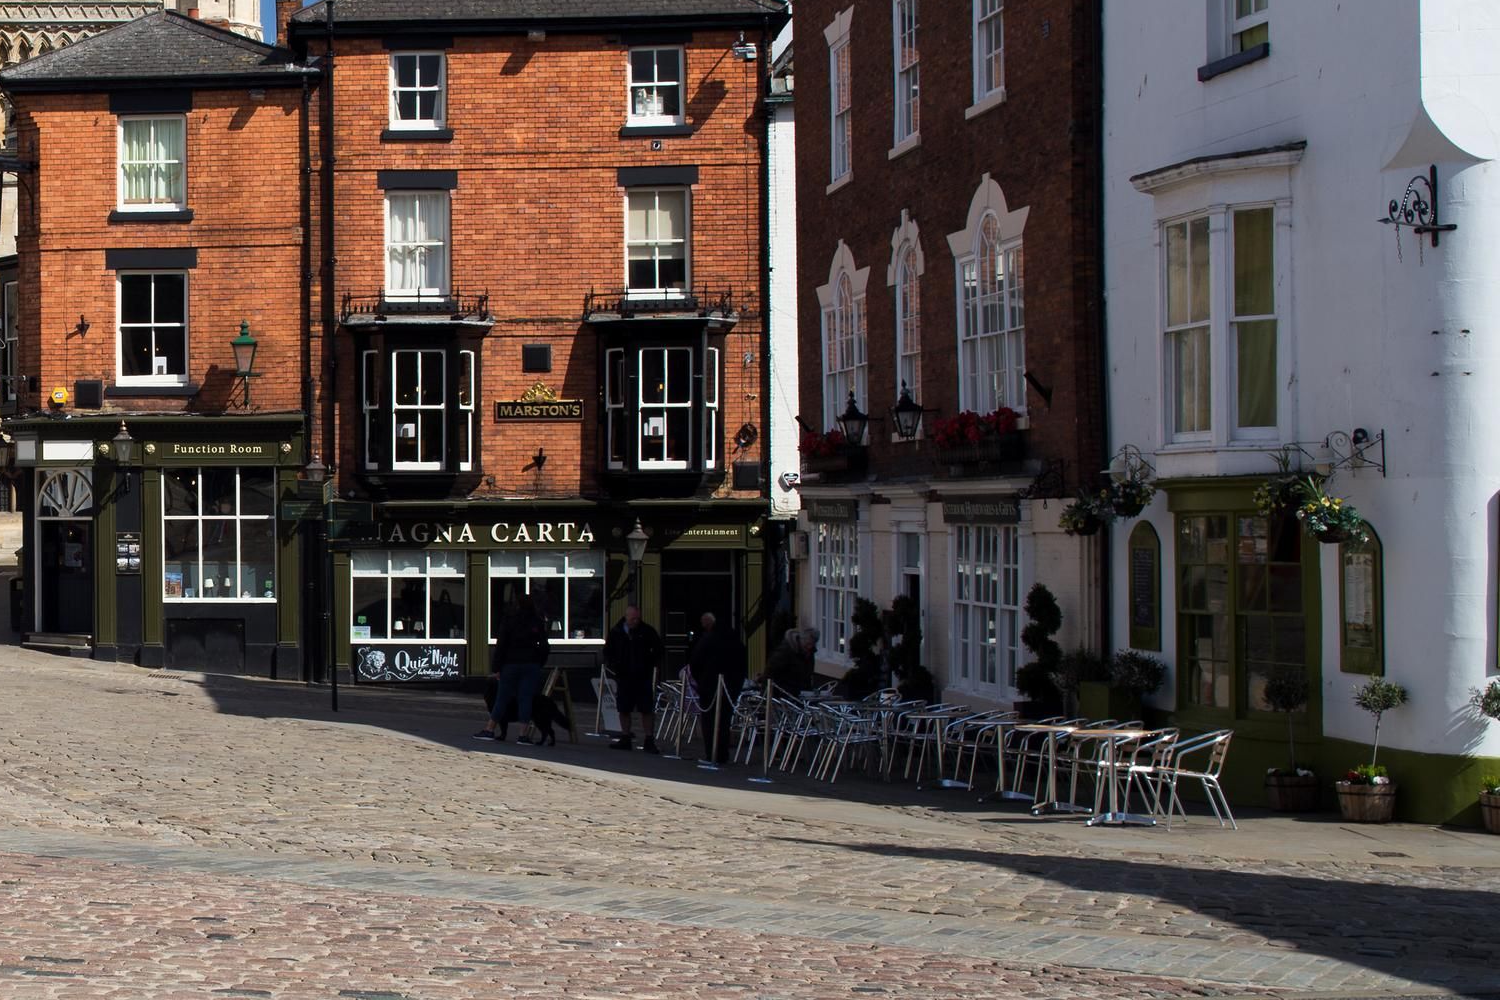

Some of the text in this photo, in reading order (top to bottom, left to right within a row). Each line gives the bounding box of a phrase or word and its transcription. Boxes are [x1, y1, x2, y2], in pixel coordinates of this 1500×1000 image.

[500, 405, 581, 416] MARSTON'S
[174, 444, 262, 453] Function Room
[490, 522, 596, 542] CARTA
[395, 649, 459, 673] Quiz Night
